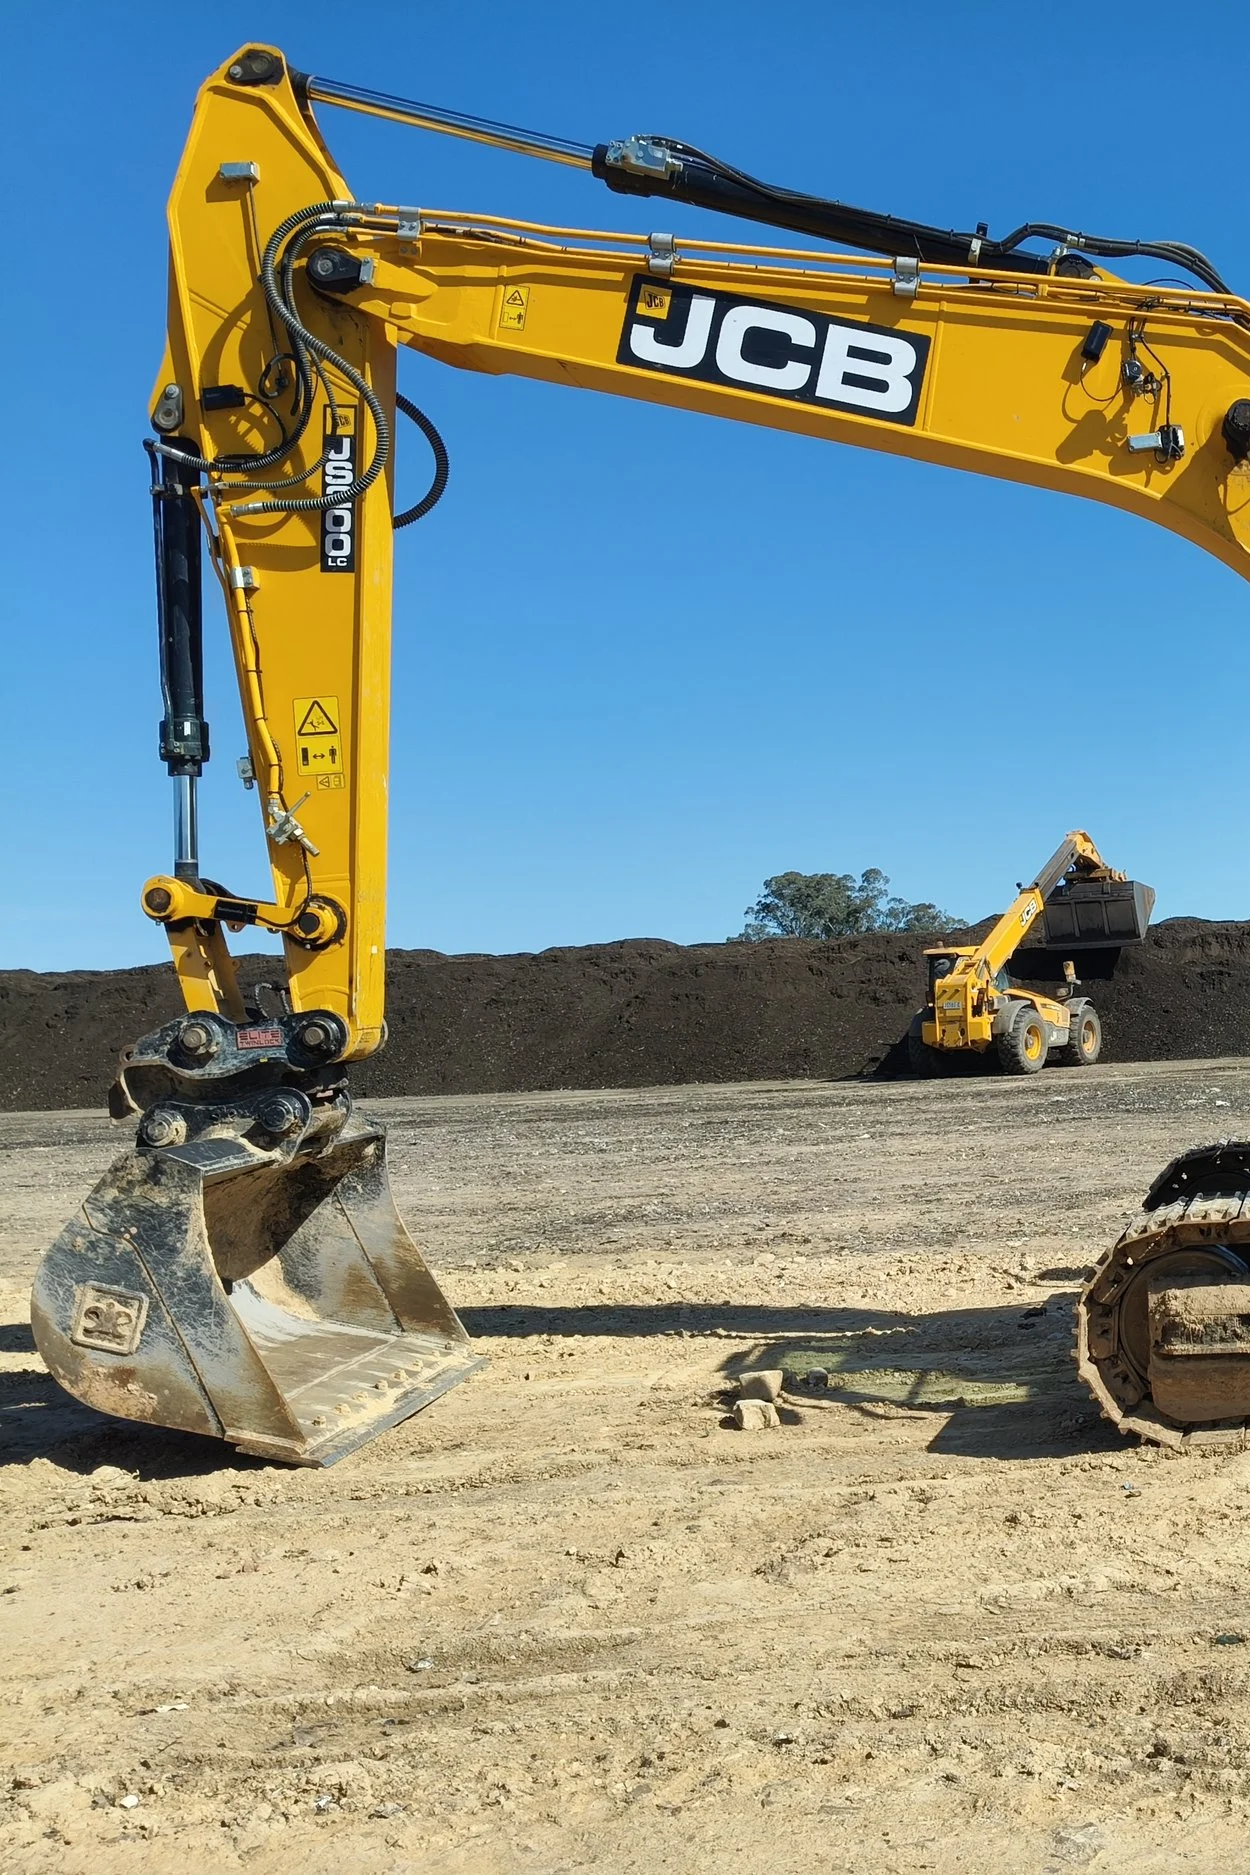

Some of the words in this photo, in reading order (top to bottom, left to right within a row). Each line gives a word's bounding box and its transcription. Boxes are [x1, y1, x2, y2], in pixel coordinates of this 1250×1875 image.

[645, 292, 666, 309] JCB
[629, 294, 917, 413] JCB
[328, 557, 348, 567] LC
[1019, 899, 1037, 927] JCB
[239, 1030, 280, 1040] ELITE
